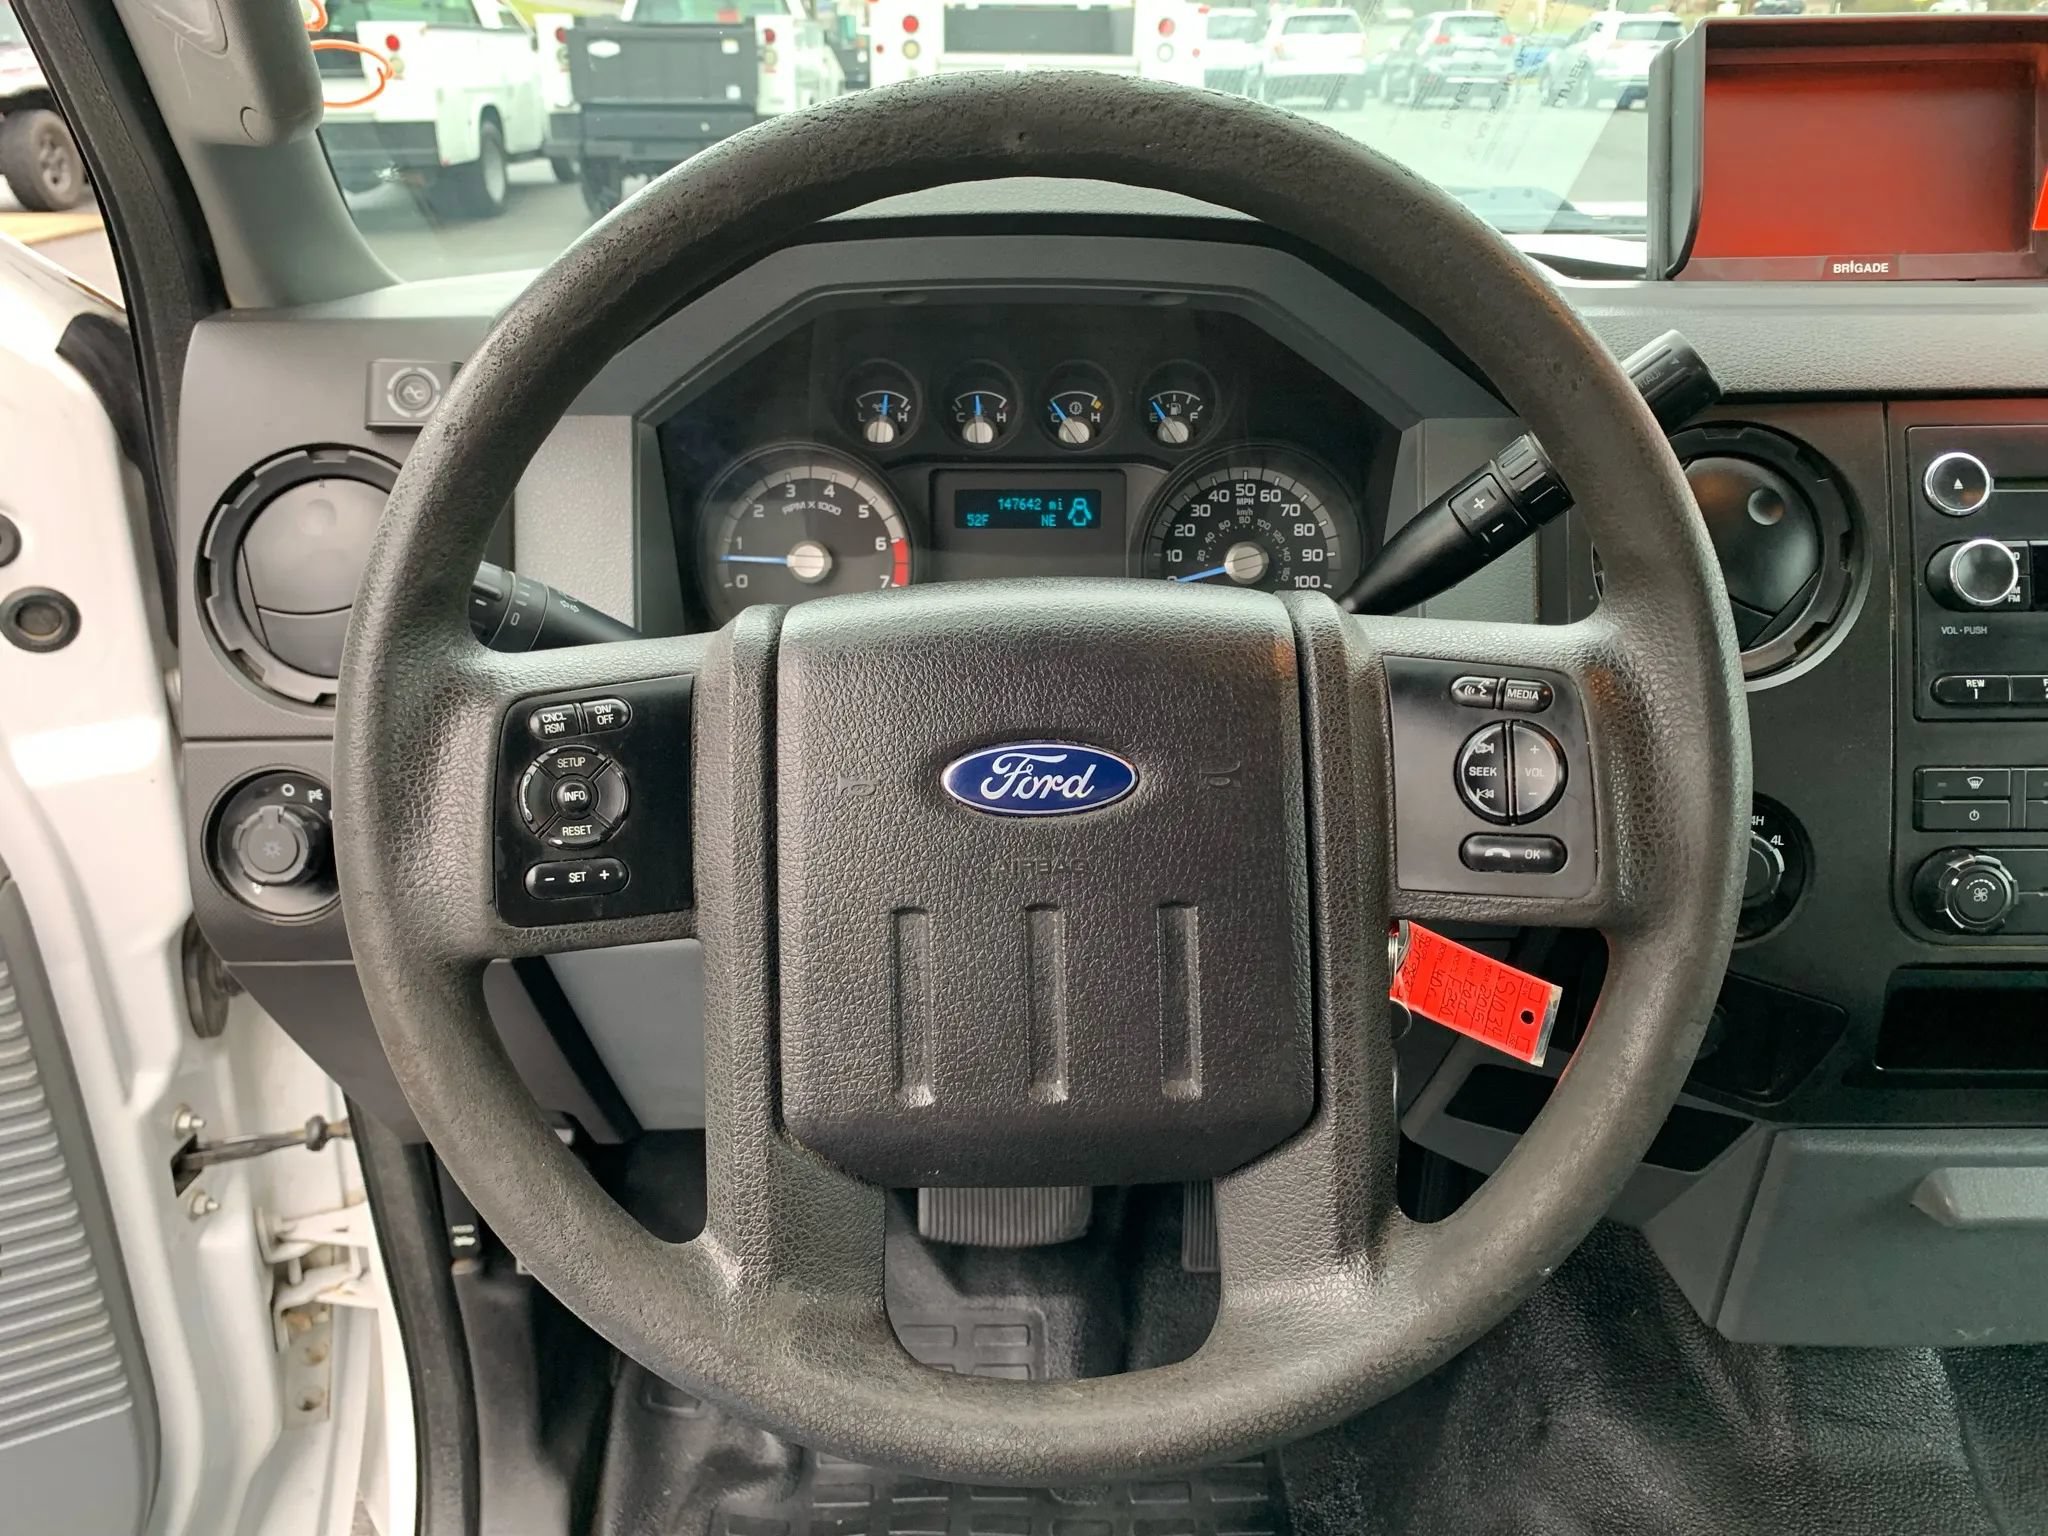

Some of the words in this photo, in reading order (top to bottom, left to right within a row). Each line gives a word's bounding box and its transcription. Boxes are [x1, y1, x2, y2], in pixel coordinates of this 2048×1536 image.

[1833, 260, 1888, 273] BRIGADE
[898, 412, 908, 423] H
[956, 412, 965, 422] C
[996, 412, 1007, 423] H
[1090, 412, 1101, 423] H
[1189, 412, 1199, 422] F
[786, 484, 797, 498] 3
[823, 484, 835, 498] 4
[1208, 489, 1230, 503] 40
[1235, 483, 1256, 497] 50
[1260, 489, 1282, 503] 60
[998, 498, 1042, 511] 147642
[1048, 498, 1064, 511] mi
[1236, 497, 1255, 505] MPH
[753, 504, 765, 518] 2
[781, 501, 806, 516] RPM
[817, 501, 842, 516] 1000
[858, 504, 870, 518] 5
[1190, 503, 1211, 518] 30
[1280, 503, 1301, 517] 70
[966, 514, 990, 527] 52F
[1041, 514, 1057, 527] NE
[1174, 523, 1196, 537] 20
[1293, 523, 1315, 537] 80
[736, 537, 743, 550] 1
[875, 537, 887, 551] 6
[1166, 549, 1183, 563] 10
[1302, 548, 1323, 563] 90
[736, 574, 748, 589] 0
[880, 575, 890, 589] 7
[1294, 575, 1321, 589] 100
[1941, 626, 1958, 635] VOL
[1963, 626, 1988, 635] PUSH
[1966, 680, 1984, 688] REW
[1507, 688, 1540, 701] MEDIA
[542, 711, 567, 723] CNCL
[597, 713, 615, 726] OFF
[544, 723, 565, 735] RSM
[557, 756, 587, 769] SETUP
[980, 752, 1096, 800] Ford
[1469, 766, 1498, 777] SEEK
[1525, 767, 1545, 778] VOL
[564, 790, 586, 802] INFO
[562, 824, 593, 837] RESET
[1771, 835, 1784, 846] 4L
[1524, 848, 1541, 860] OK
[568, 871, 587, 883] SET
[1474, 983, 1492, 1025] 2015
[1487, 976, 1517, 1037] S1034
